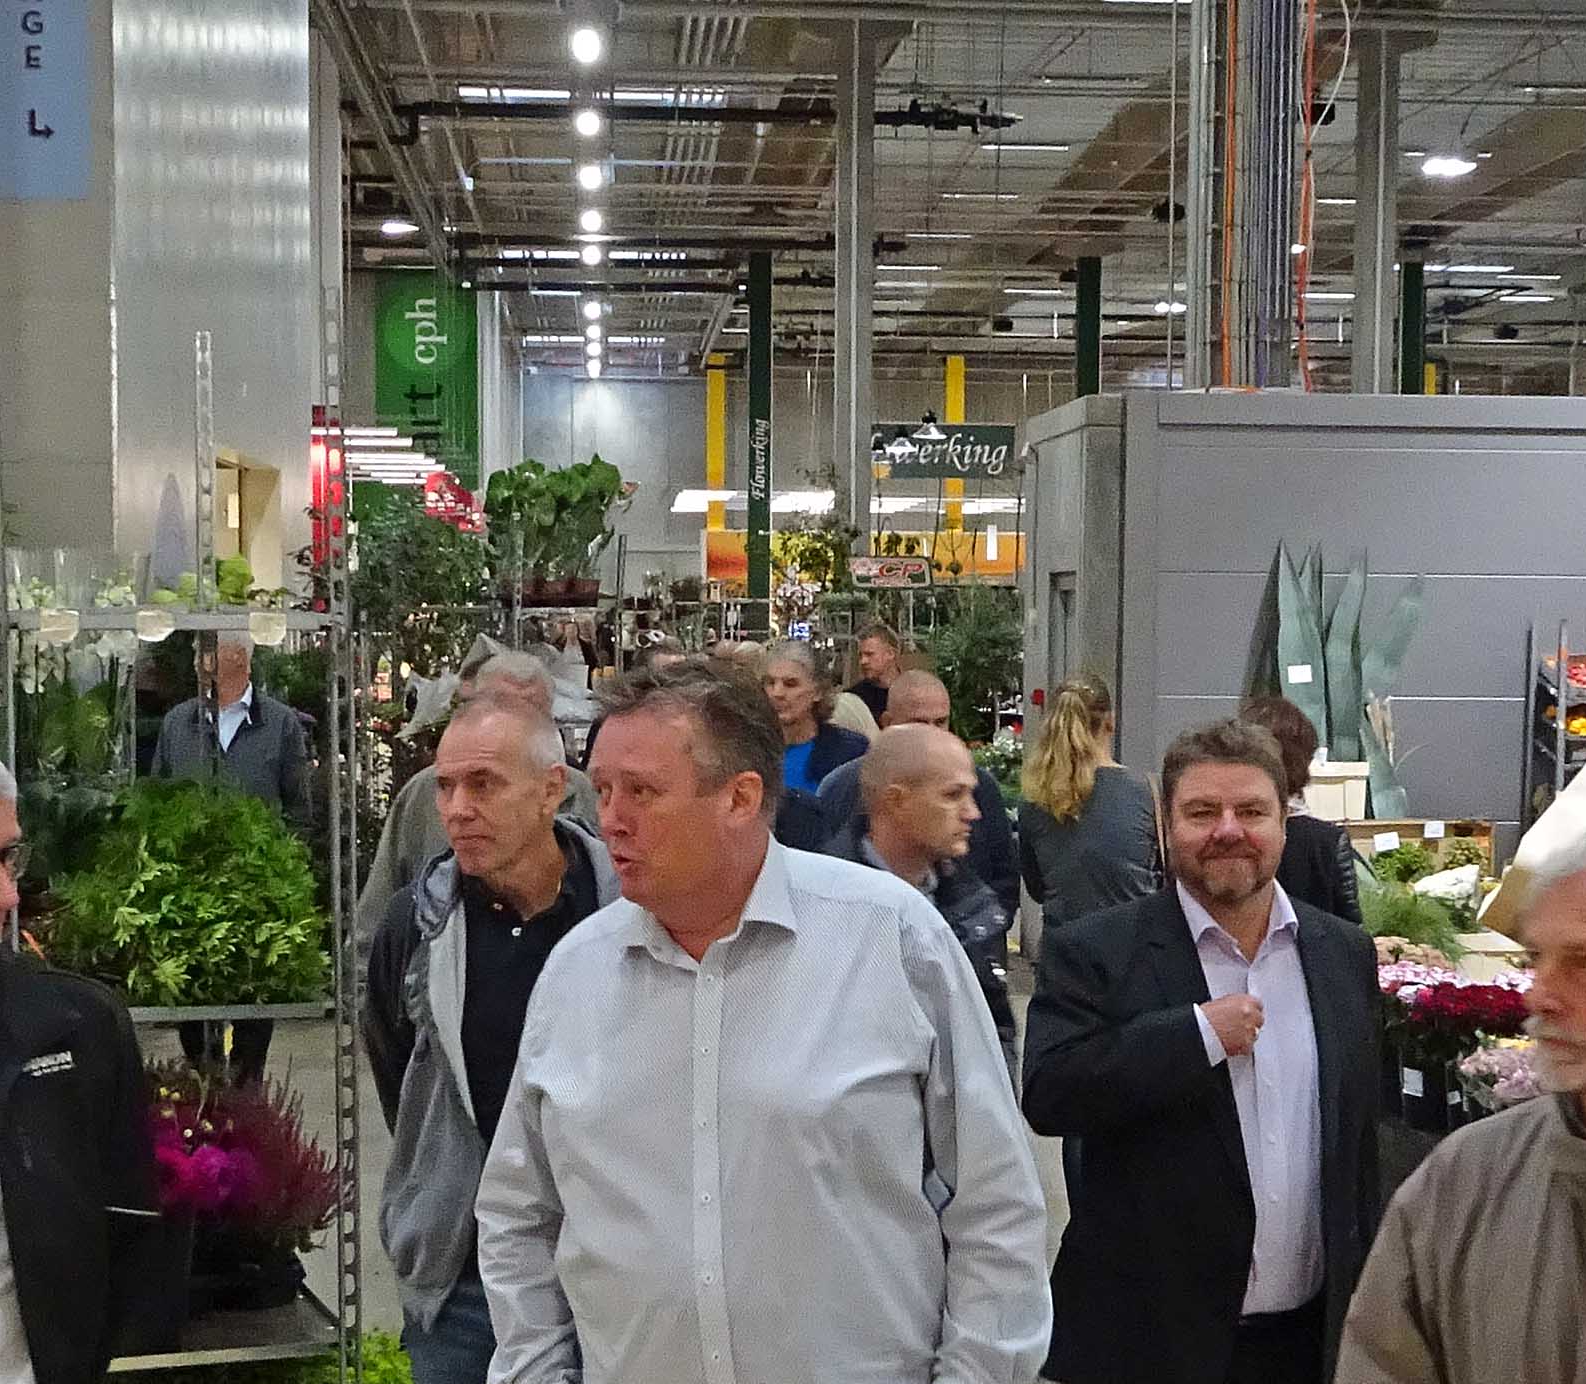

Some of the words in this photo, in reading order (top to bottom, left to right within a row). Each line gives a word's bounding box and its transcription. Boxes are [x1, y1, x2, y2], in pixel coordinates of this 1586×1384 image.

[19, 0, 45, 69] GE
[405, 297, 448, 364] cph
[750, 418, 769, 500] Flowerking
